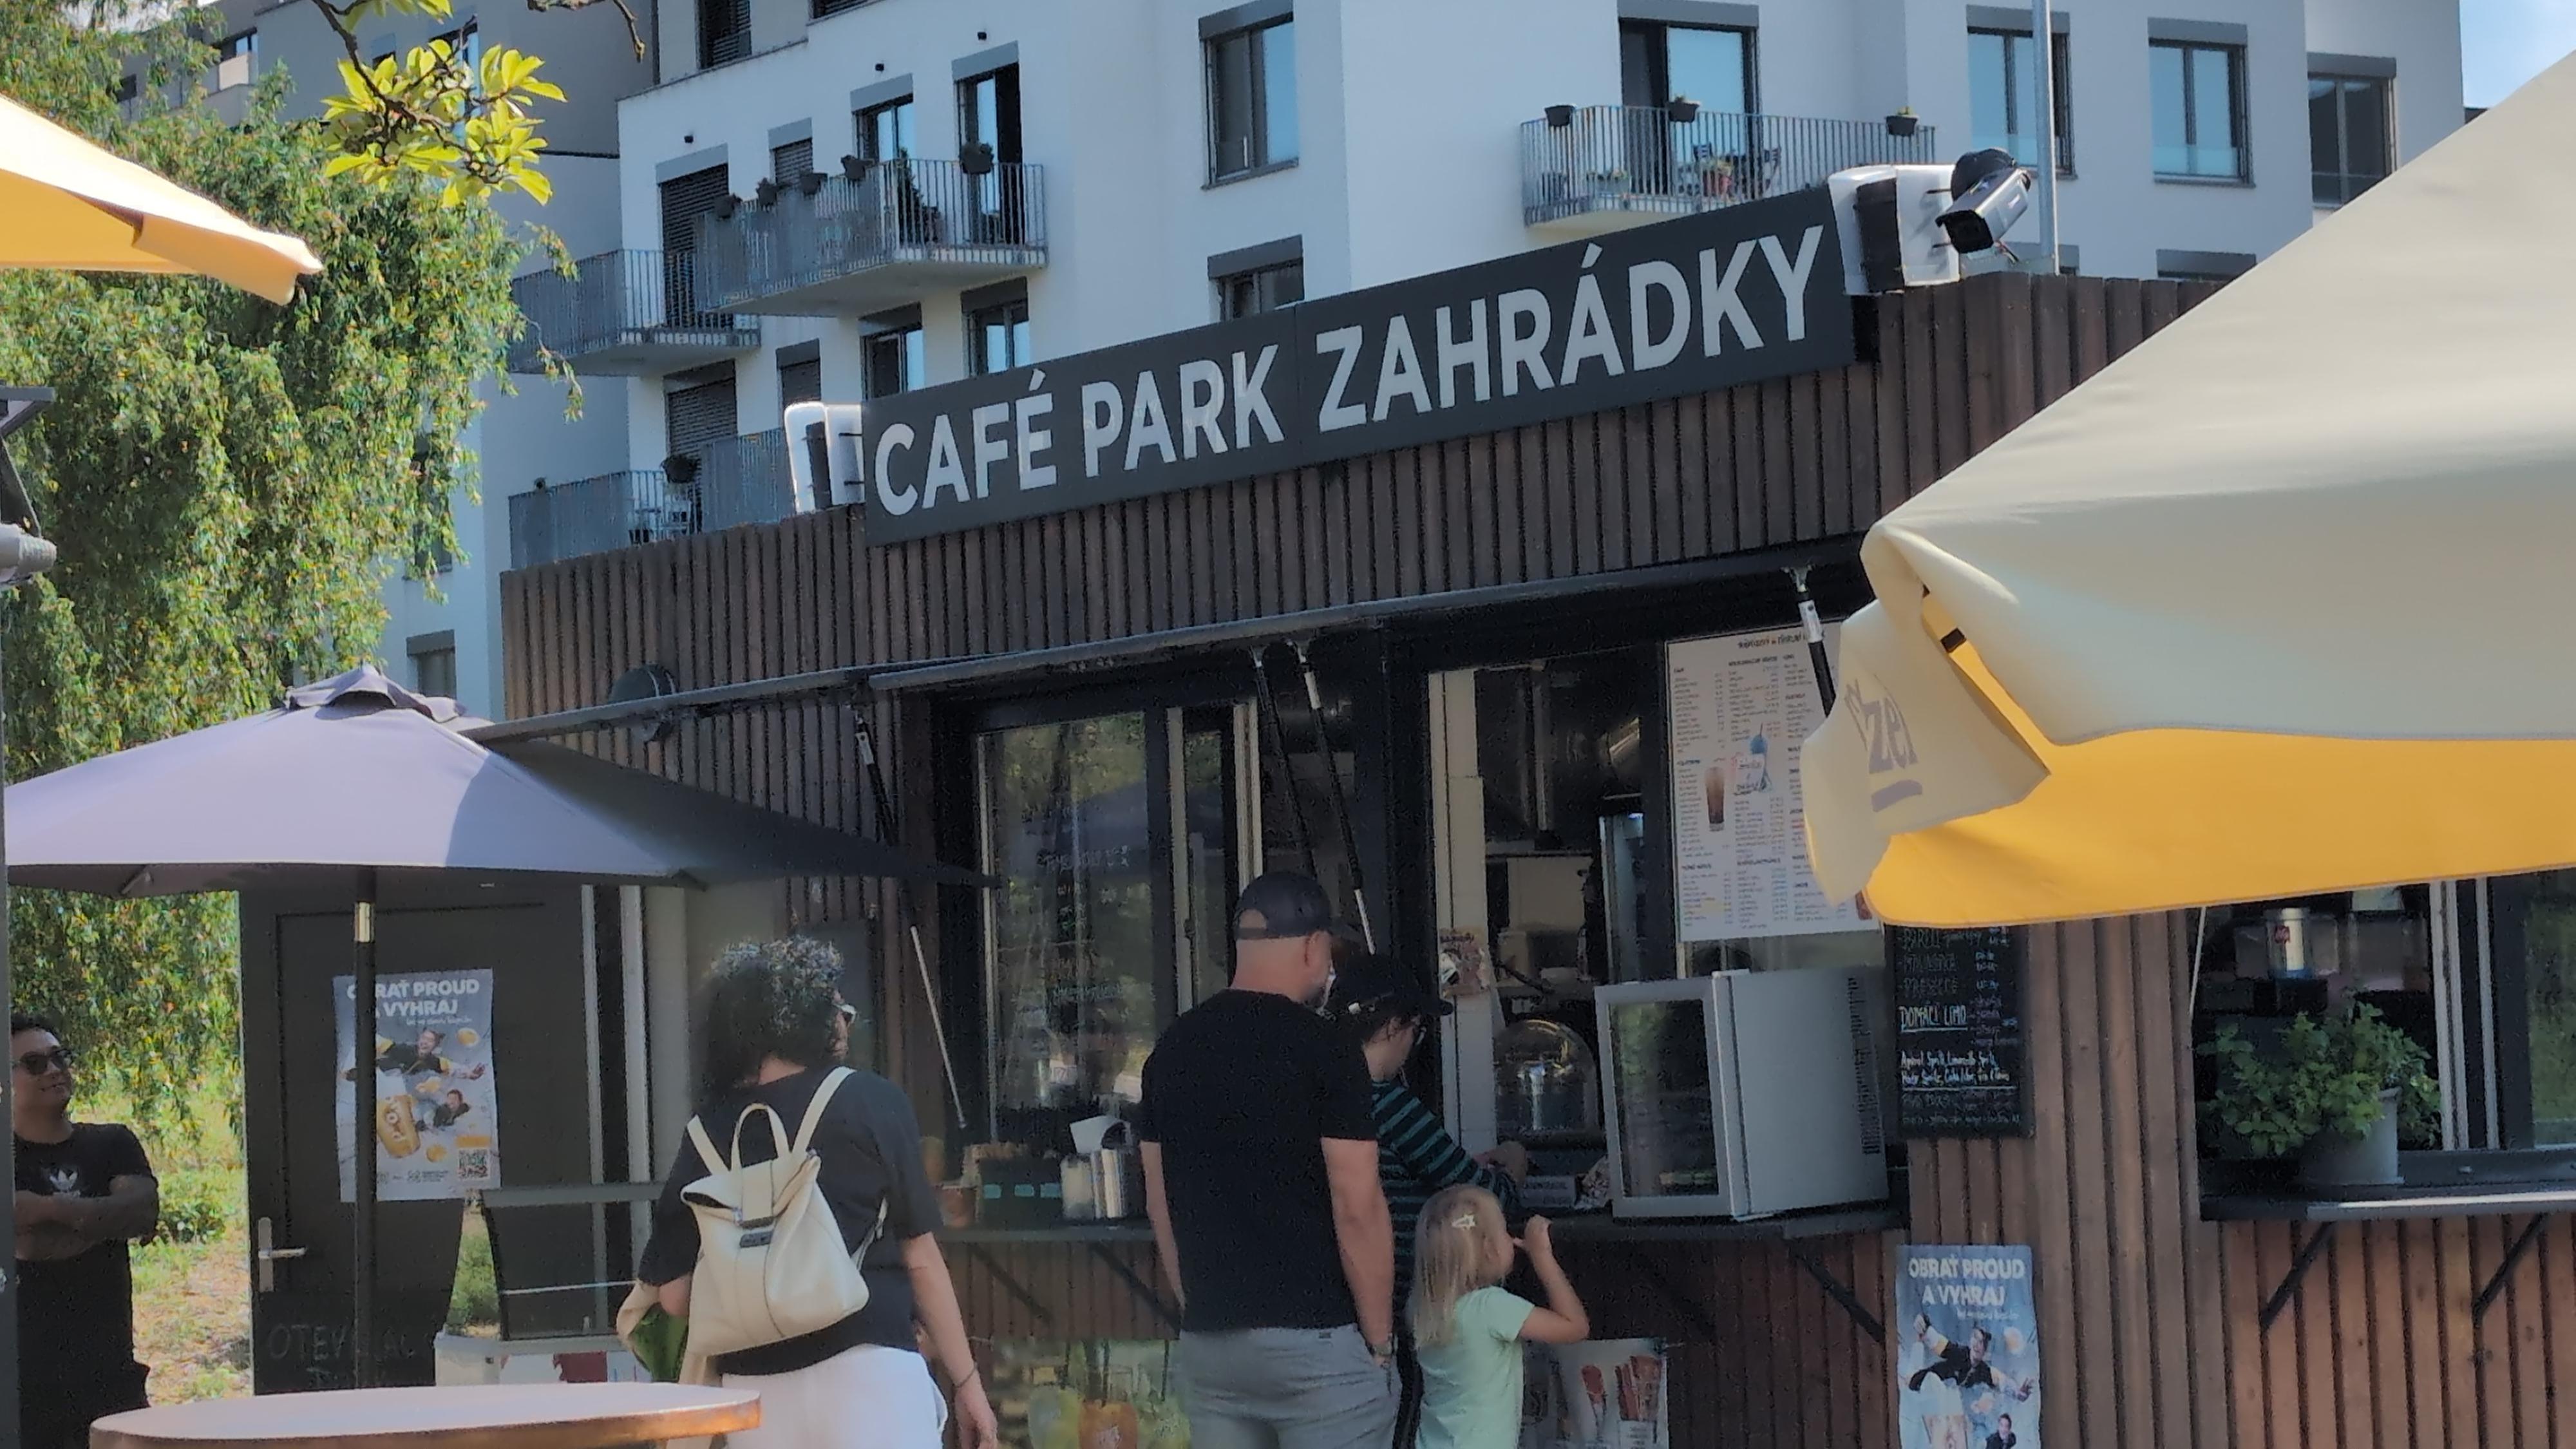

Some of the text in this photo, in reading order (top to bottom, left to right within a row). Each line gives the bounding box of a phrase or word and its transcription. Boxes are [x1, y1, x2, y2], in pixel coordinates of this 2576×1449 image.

[874, 225, 1824, 516] CAFÉ PARK ZAHRÁDKY
[346, 978, 480, 999] ORAŤ PROUD
[1962, 1258, 2025, 1280] PROUD
[1922, 1285, 2005, 1307] A VYHRAJ
